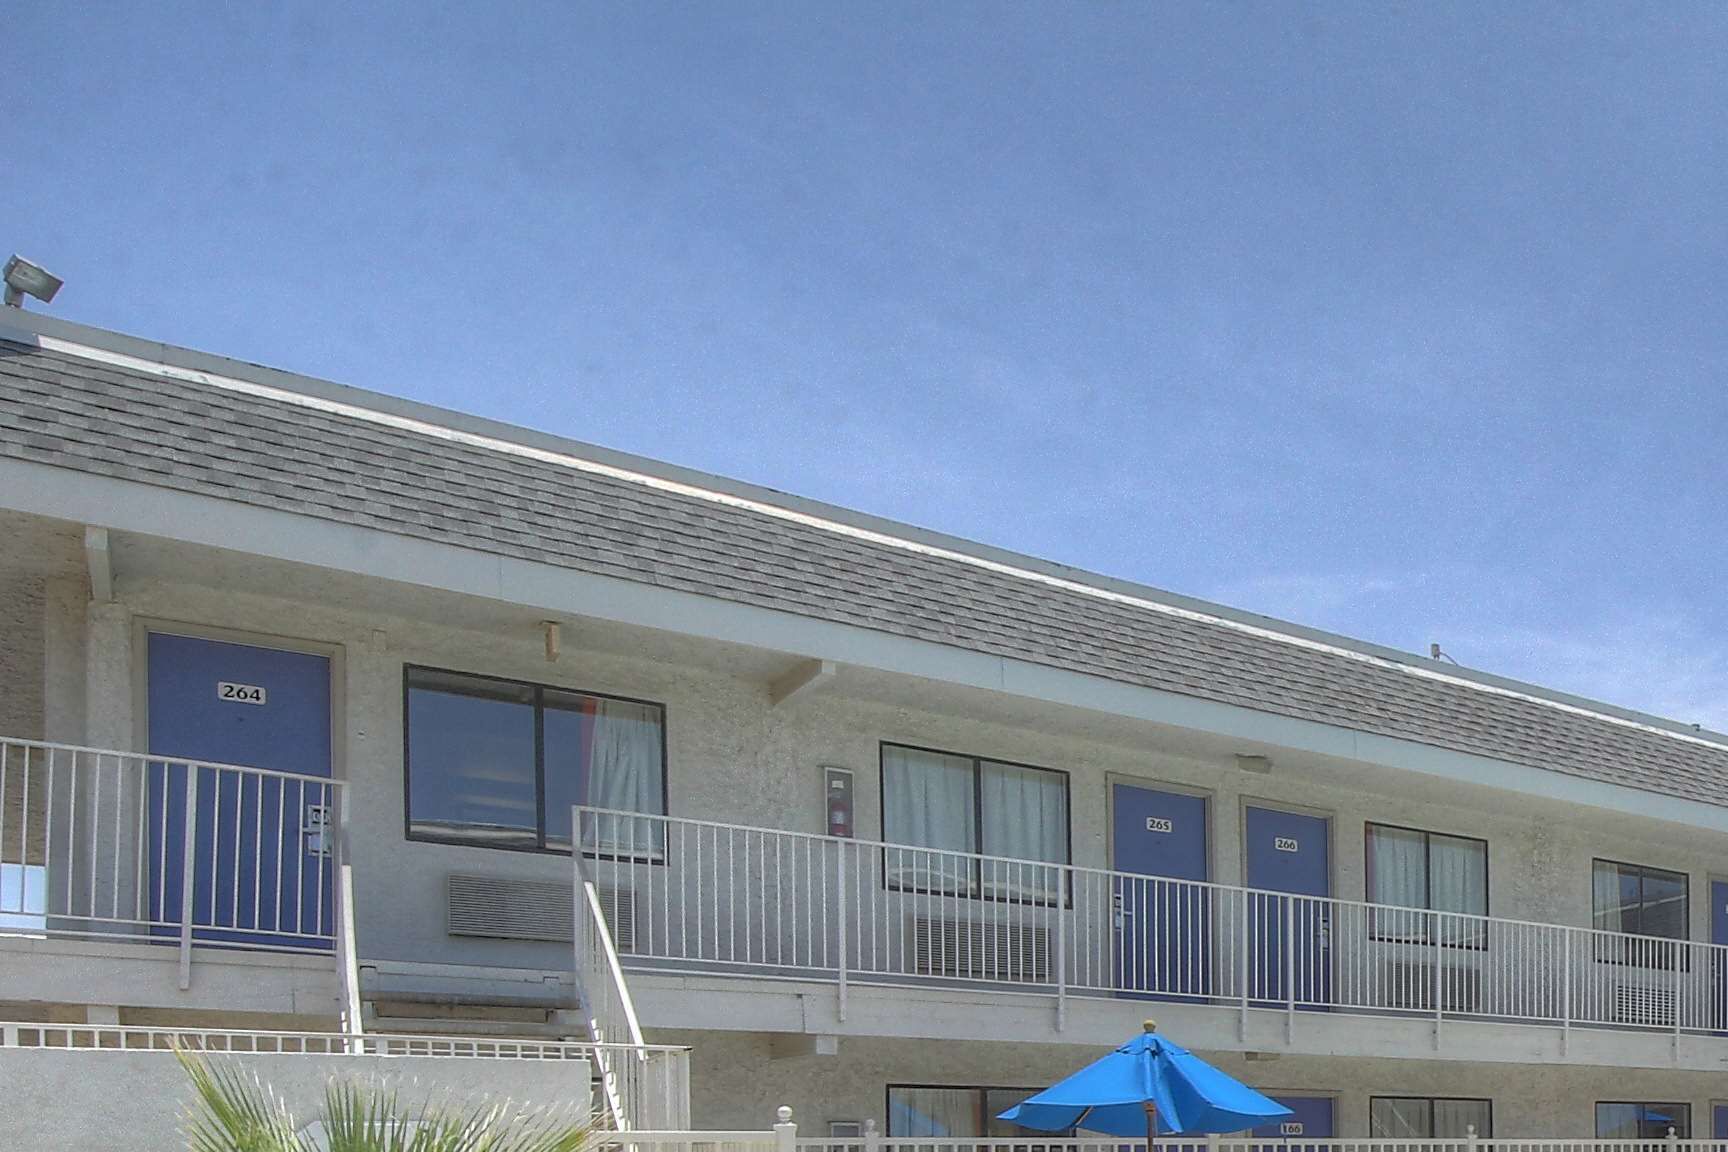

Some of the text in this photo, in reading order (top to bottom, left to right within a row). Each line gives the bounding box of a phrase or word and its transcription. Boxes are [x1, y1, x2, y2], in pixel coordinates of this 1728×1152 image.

[223, 685, 261, 701] 264
[1149, 819, 1169, 830] 265
[1277, 839, 1296, 850] 266
[1283, 1124, 1301, 1133] 166
